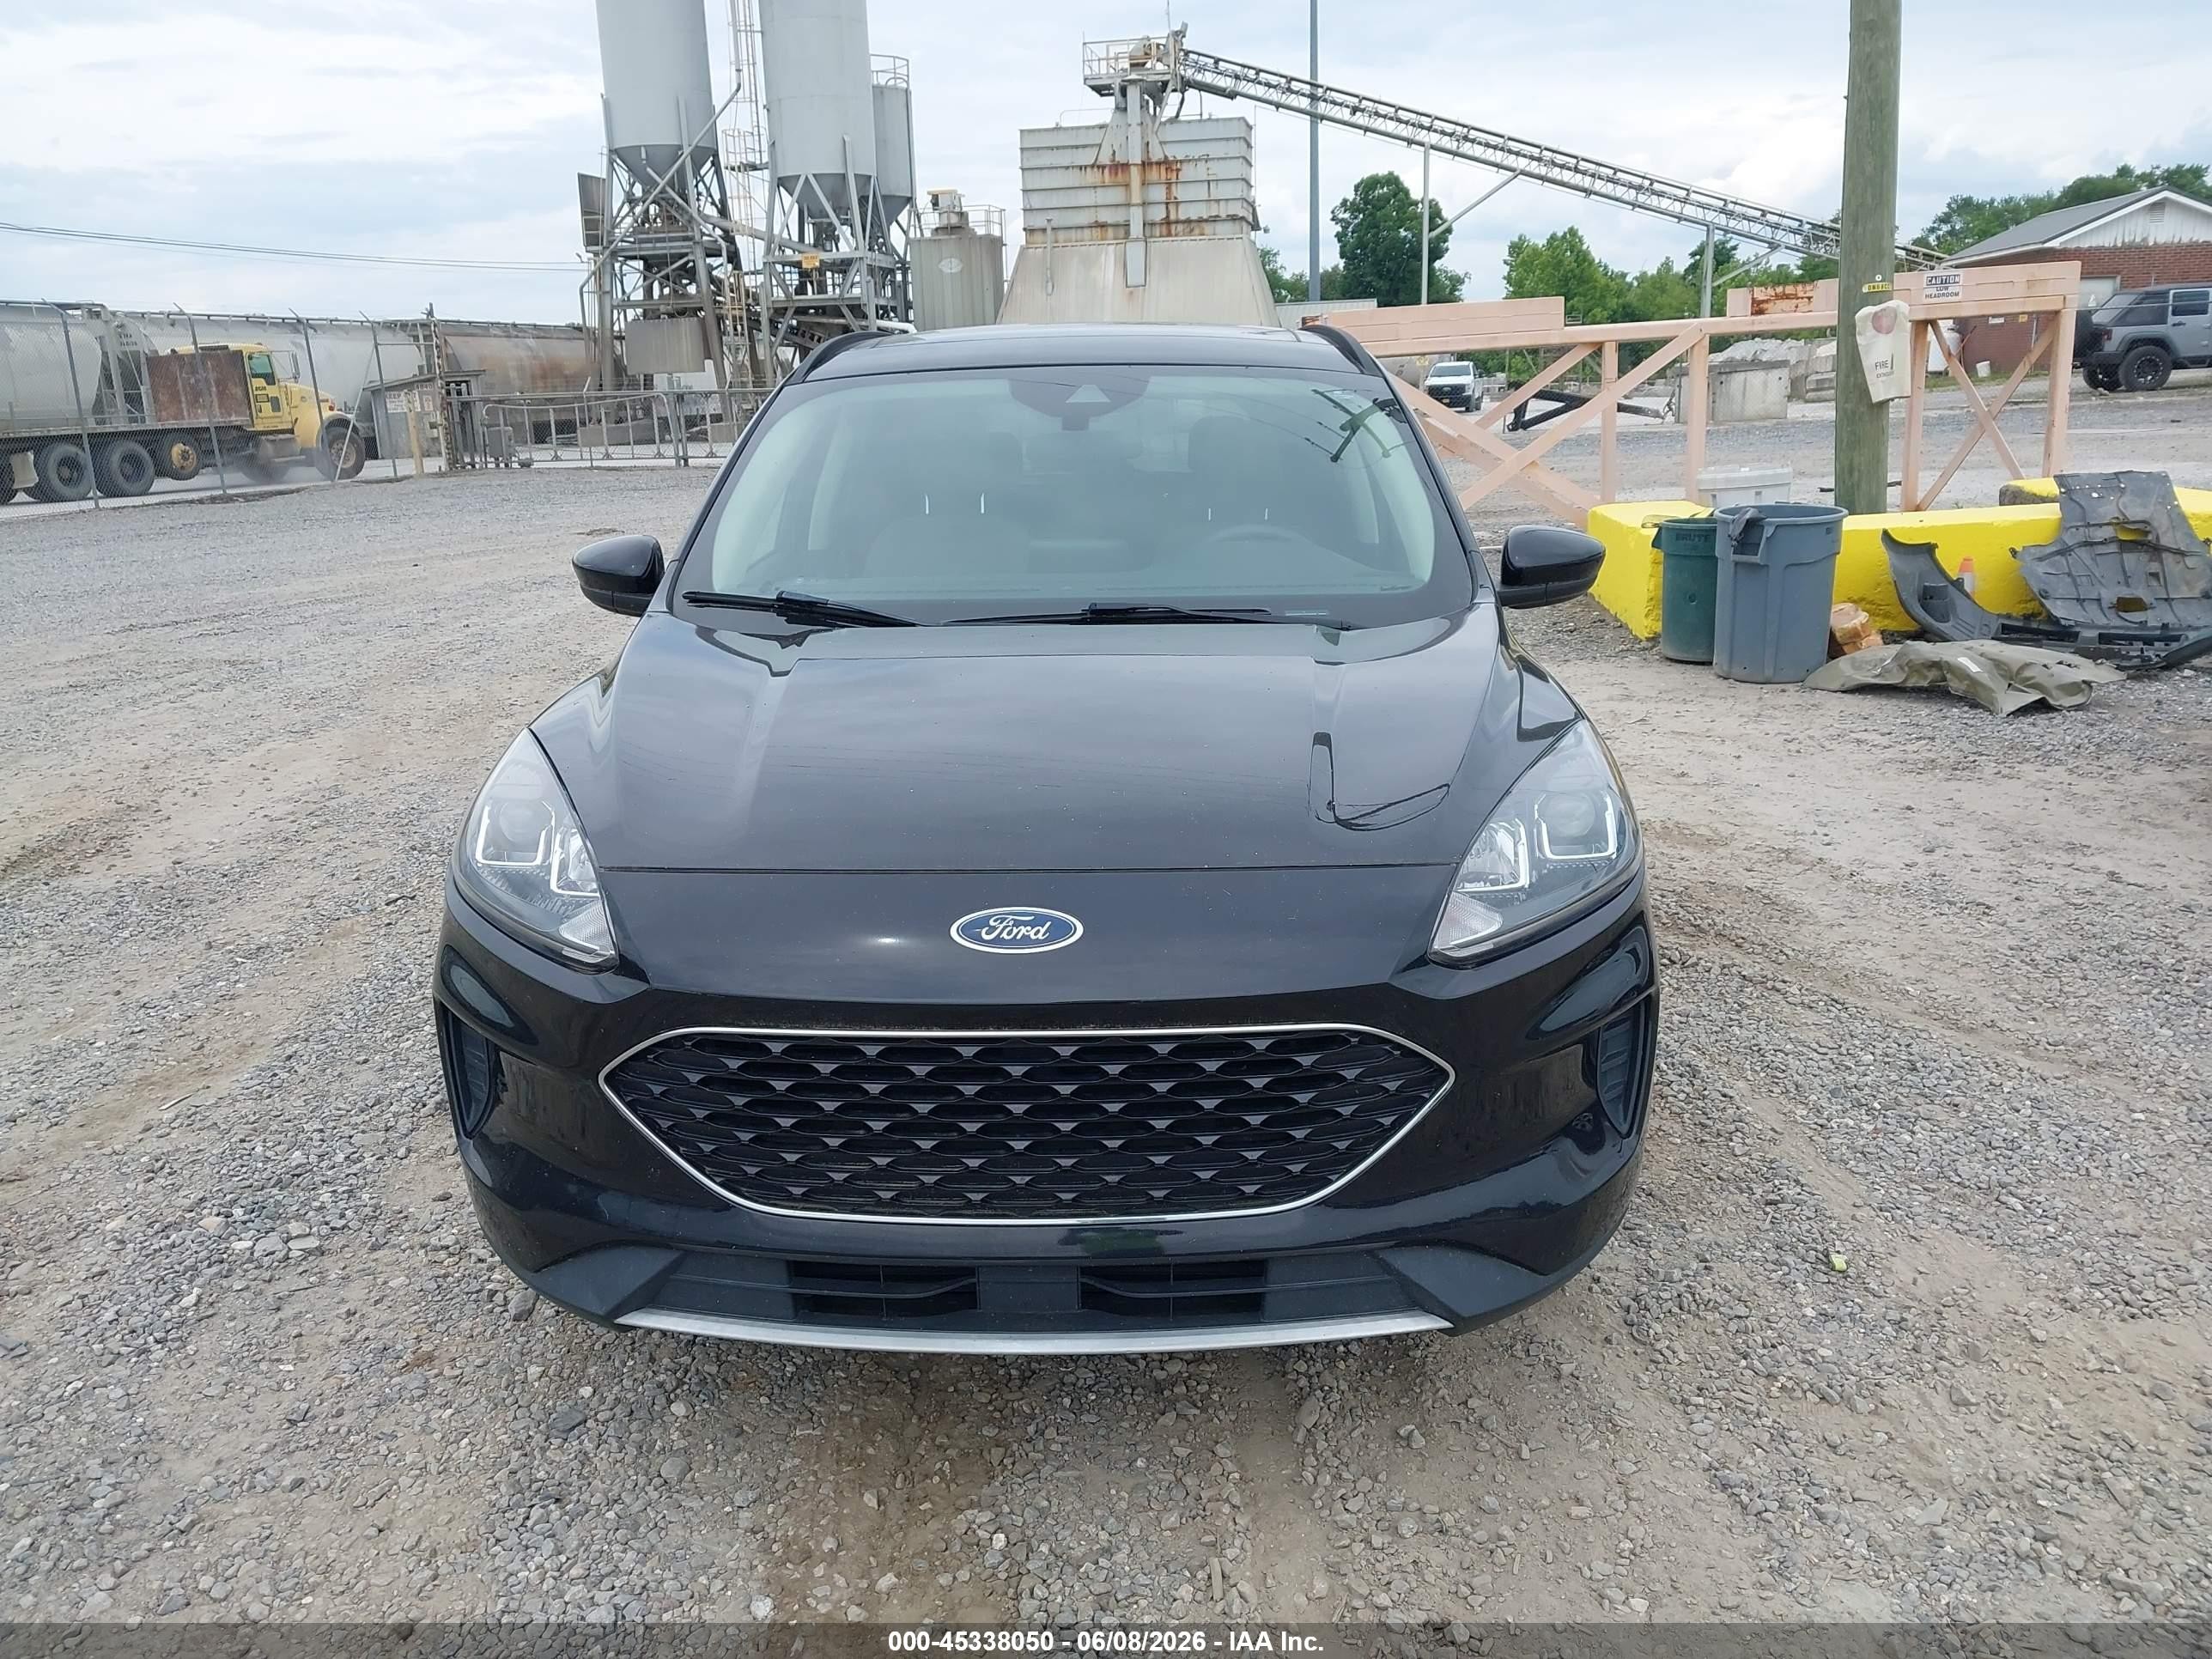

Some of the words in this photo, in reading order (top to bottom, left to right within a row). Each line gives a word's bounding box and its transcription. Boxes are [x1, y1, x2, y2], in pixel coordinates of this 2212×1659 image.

[1926, 275, 1960, 286] CAUTION
[1924, 291, 1960, 300] HEADROOM
[1875, 359, 1889, 370] FIRE
[975, 915, 1050, 940] Ford
